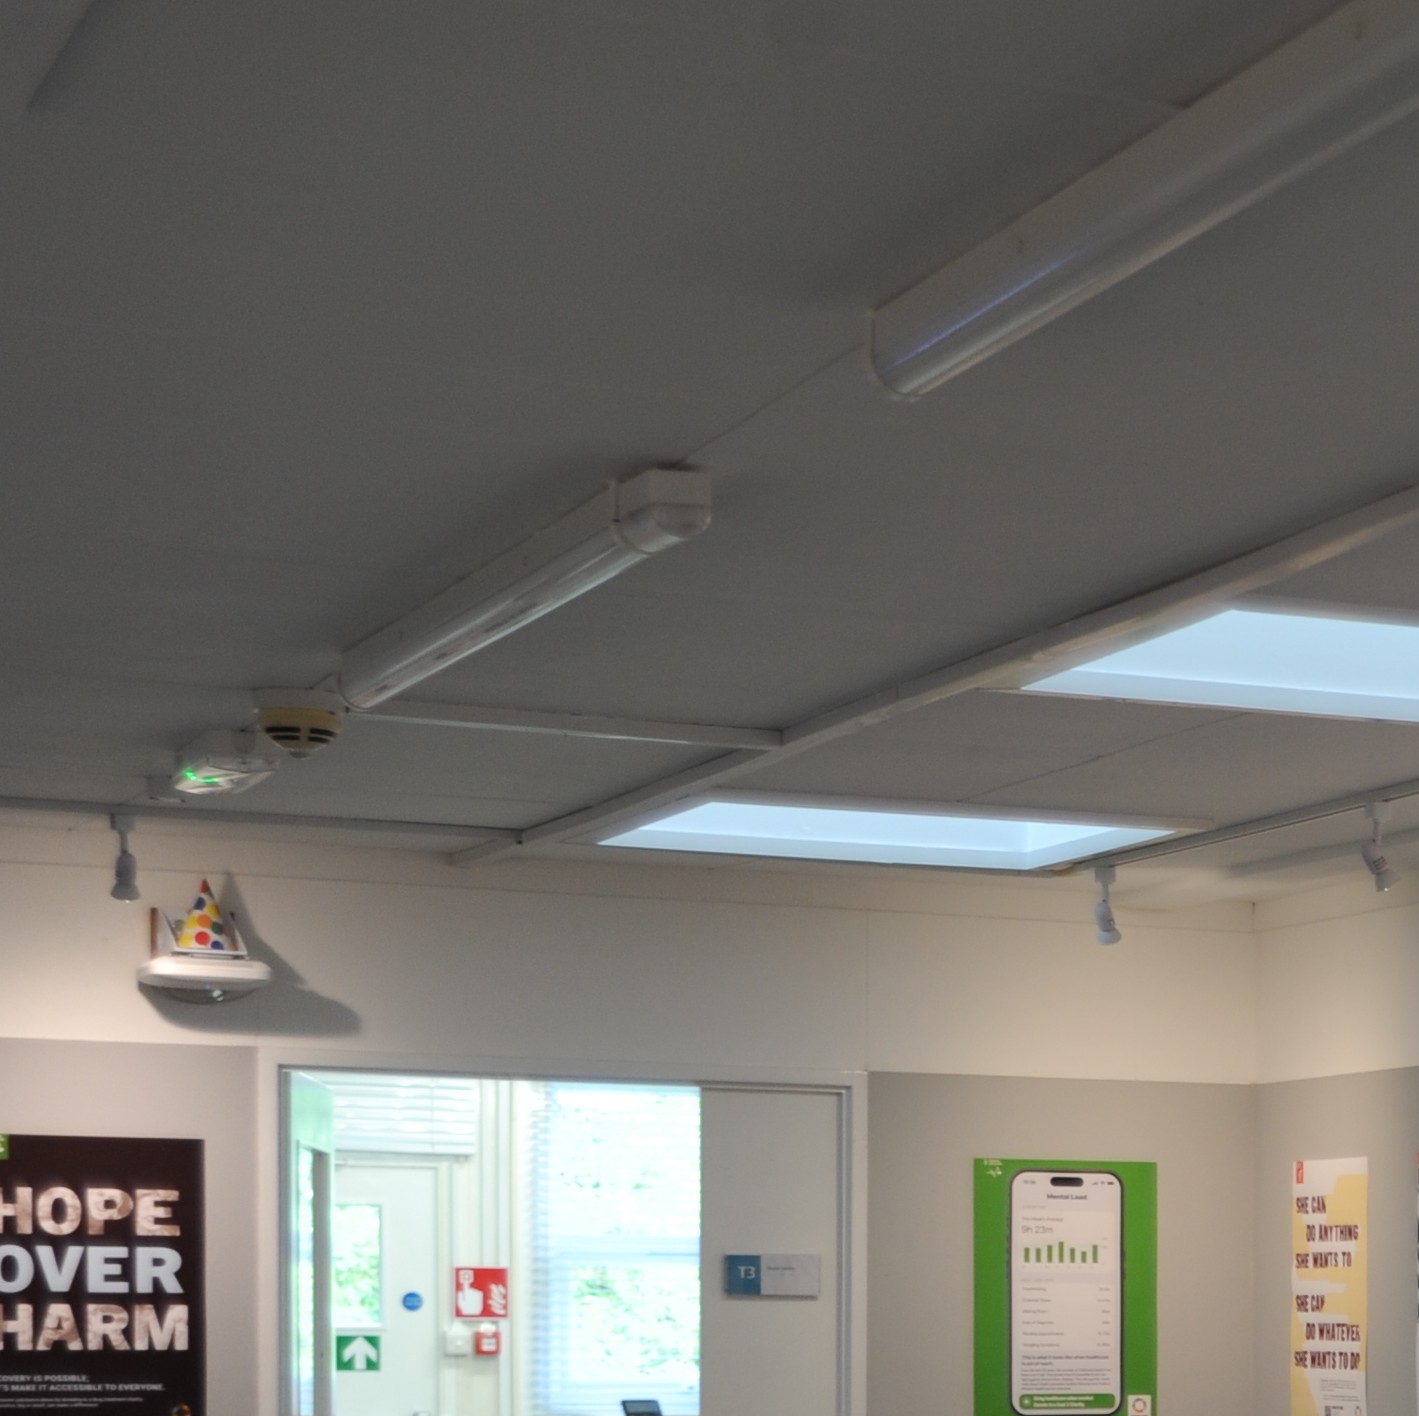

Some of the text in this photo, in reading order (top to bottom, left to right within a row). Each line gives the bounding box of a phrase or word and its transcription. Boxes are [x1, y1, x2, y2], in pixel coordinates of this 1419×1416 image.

[0, 1186, 181, 1236] HOPE
[1296, 1196, 1326, 1214] SHE CAN
[1306, 1224, 1359, 1242] DO ANYTHING
[0, 1244, 184, 1294] OVER
[1295, 1251, 1352, 1269] SHE WANTS TO
[738, 1266, 755, 1279] T3
[1296, 1294, 1325, 1312] SHE CAN
[0, 1302, 189, 1351] HARM
[1306, 1322, 1360, 1341] DO WHATEVER
[1294, 1351, 1361, 1370] SHE WANTS TO DO
